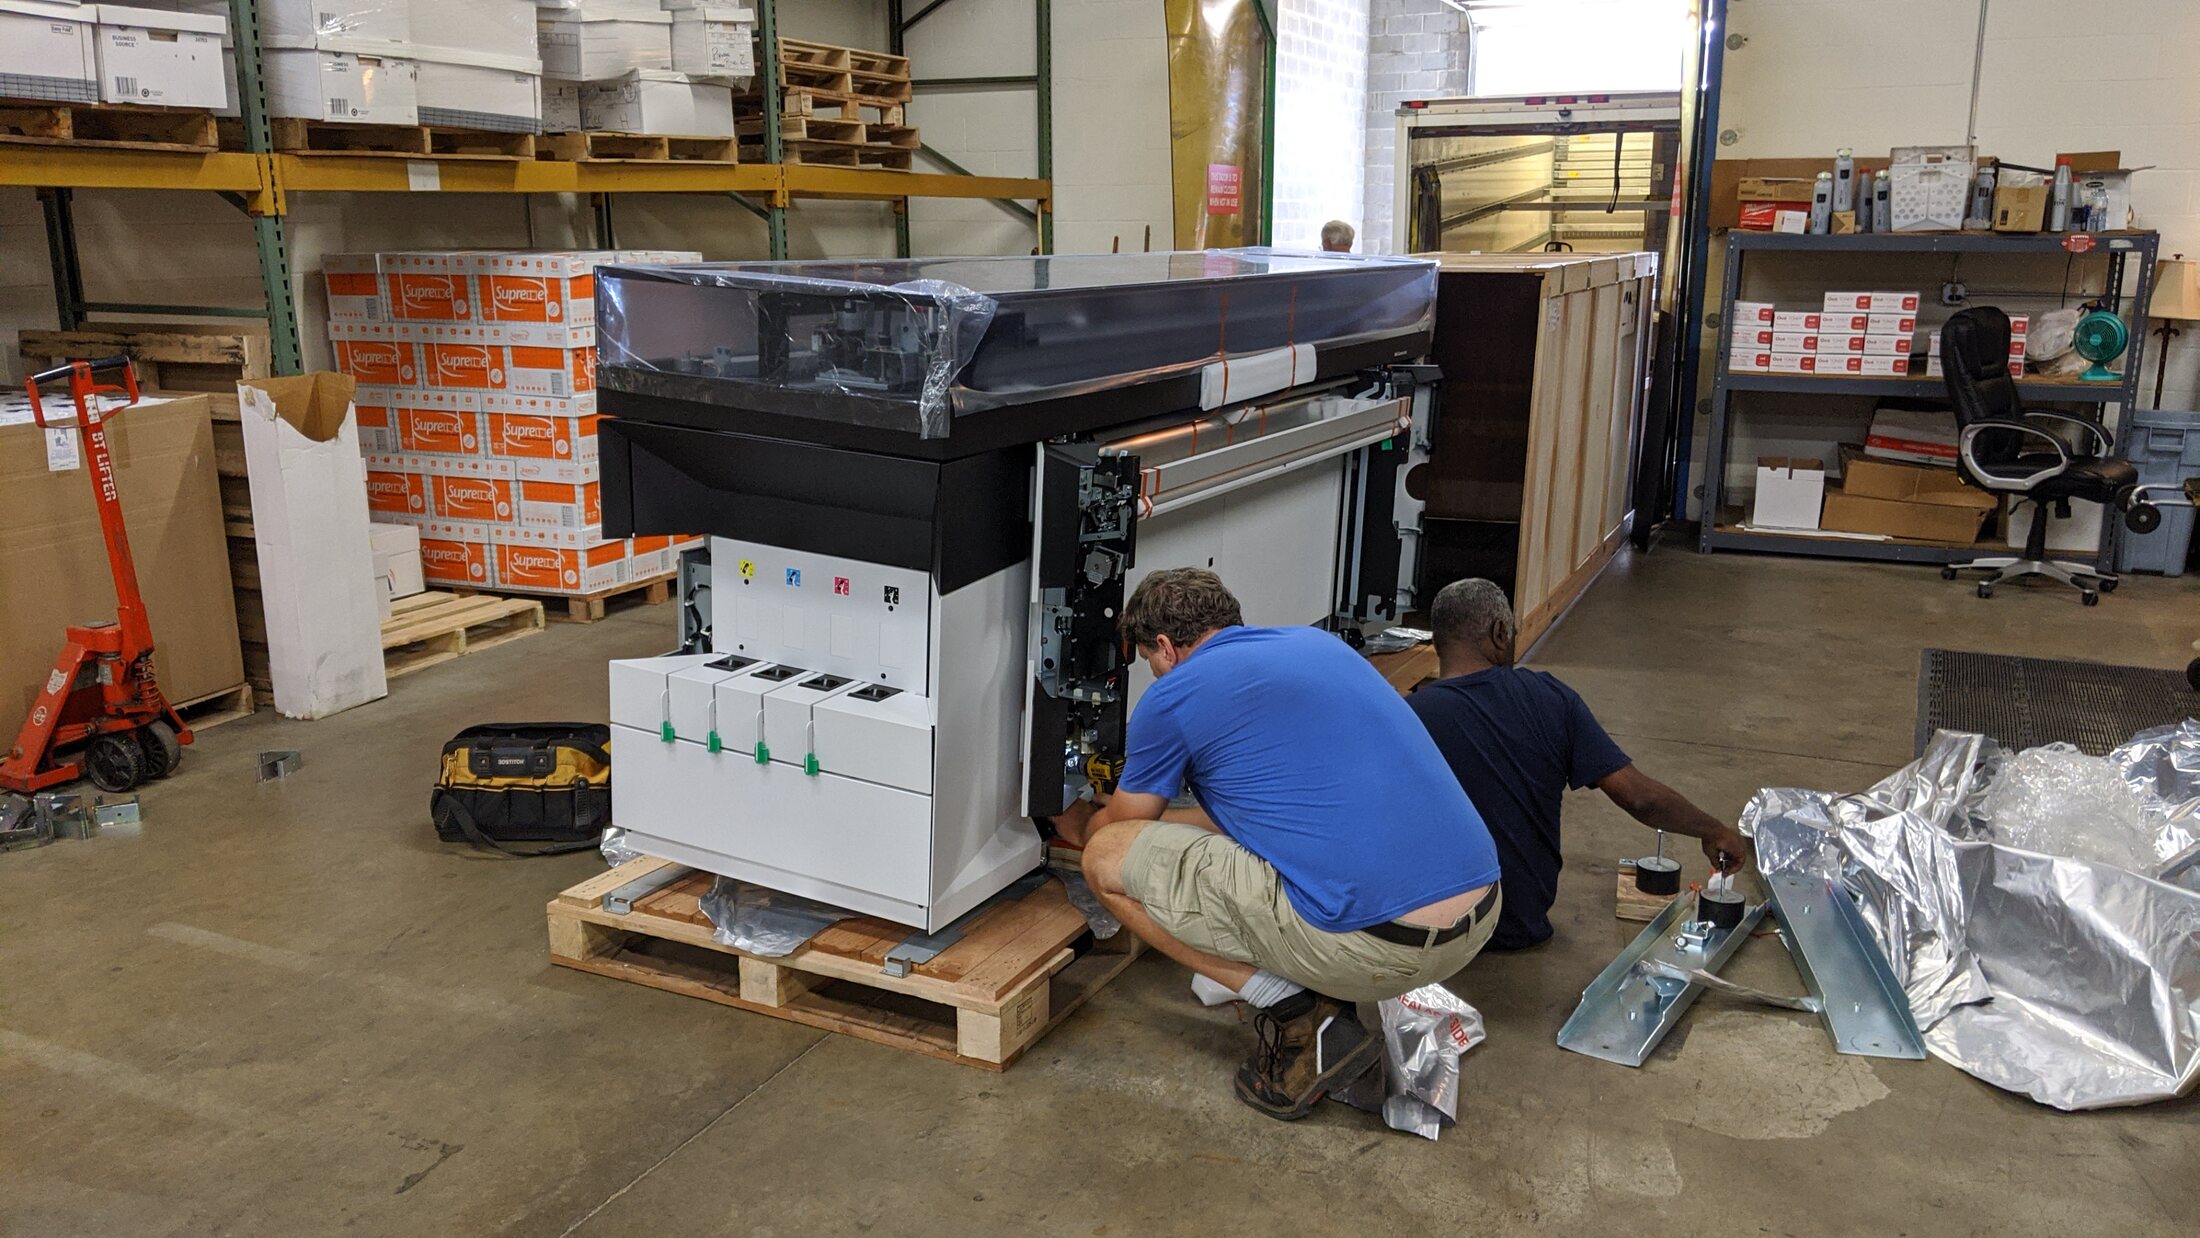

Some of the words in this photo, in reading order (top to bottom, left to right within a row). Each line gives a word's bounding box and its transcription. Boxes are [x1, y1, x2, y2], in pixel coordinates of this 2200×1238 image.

[112, 34, 136, 42] BUSINESS
[406, 283, 452, 302] Supreme
[496, 285, 544, 304] Supreme
[354, 350, 399, 367] Supreme
[442, 352, 488, 370] Supreme
[414, 418, 460, 434] Supreme
[506, 422, 553, 440] Supreme
[92, 431, 106, 450] BT
[96, 453, 117, 502] LIFTER
[368, 480, 408, 495] upreme
[448, 484, 494, 502] Supreme
[421, 545, 467, 563] Supreme
[514, 552, 560, 570] Supreme
